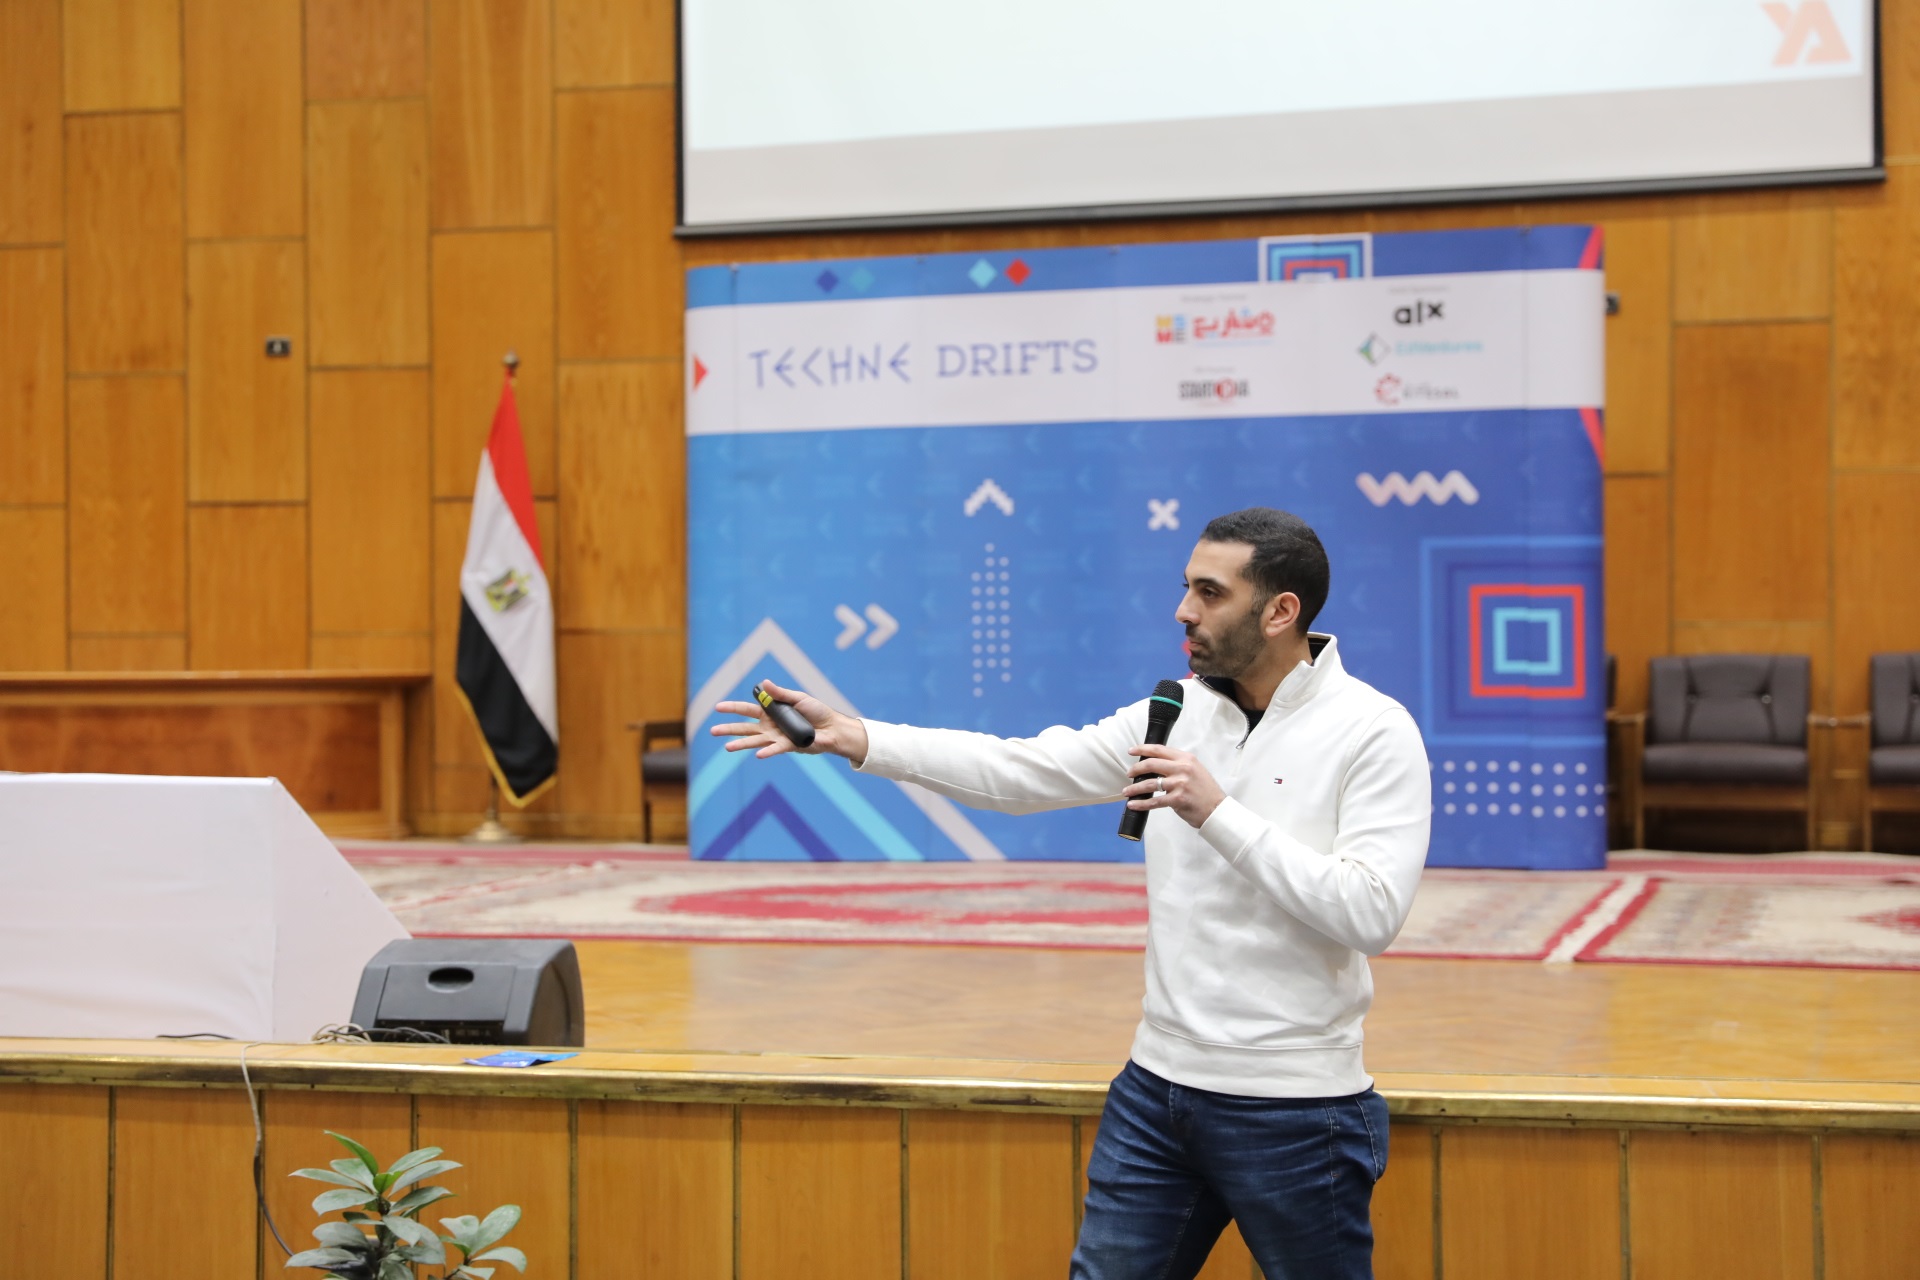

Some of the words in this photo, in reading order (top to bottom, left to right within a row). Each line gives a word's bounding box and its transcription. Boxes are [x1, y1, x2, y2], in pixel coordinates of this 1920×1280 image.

[1394, 299, 1444, 325] alx
[748, 342, 910, 388] TECHNE
[936, 339, 1098, 378] DRIFTS
